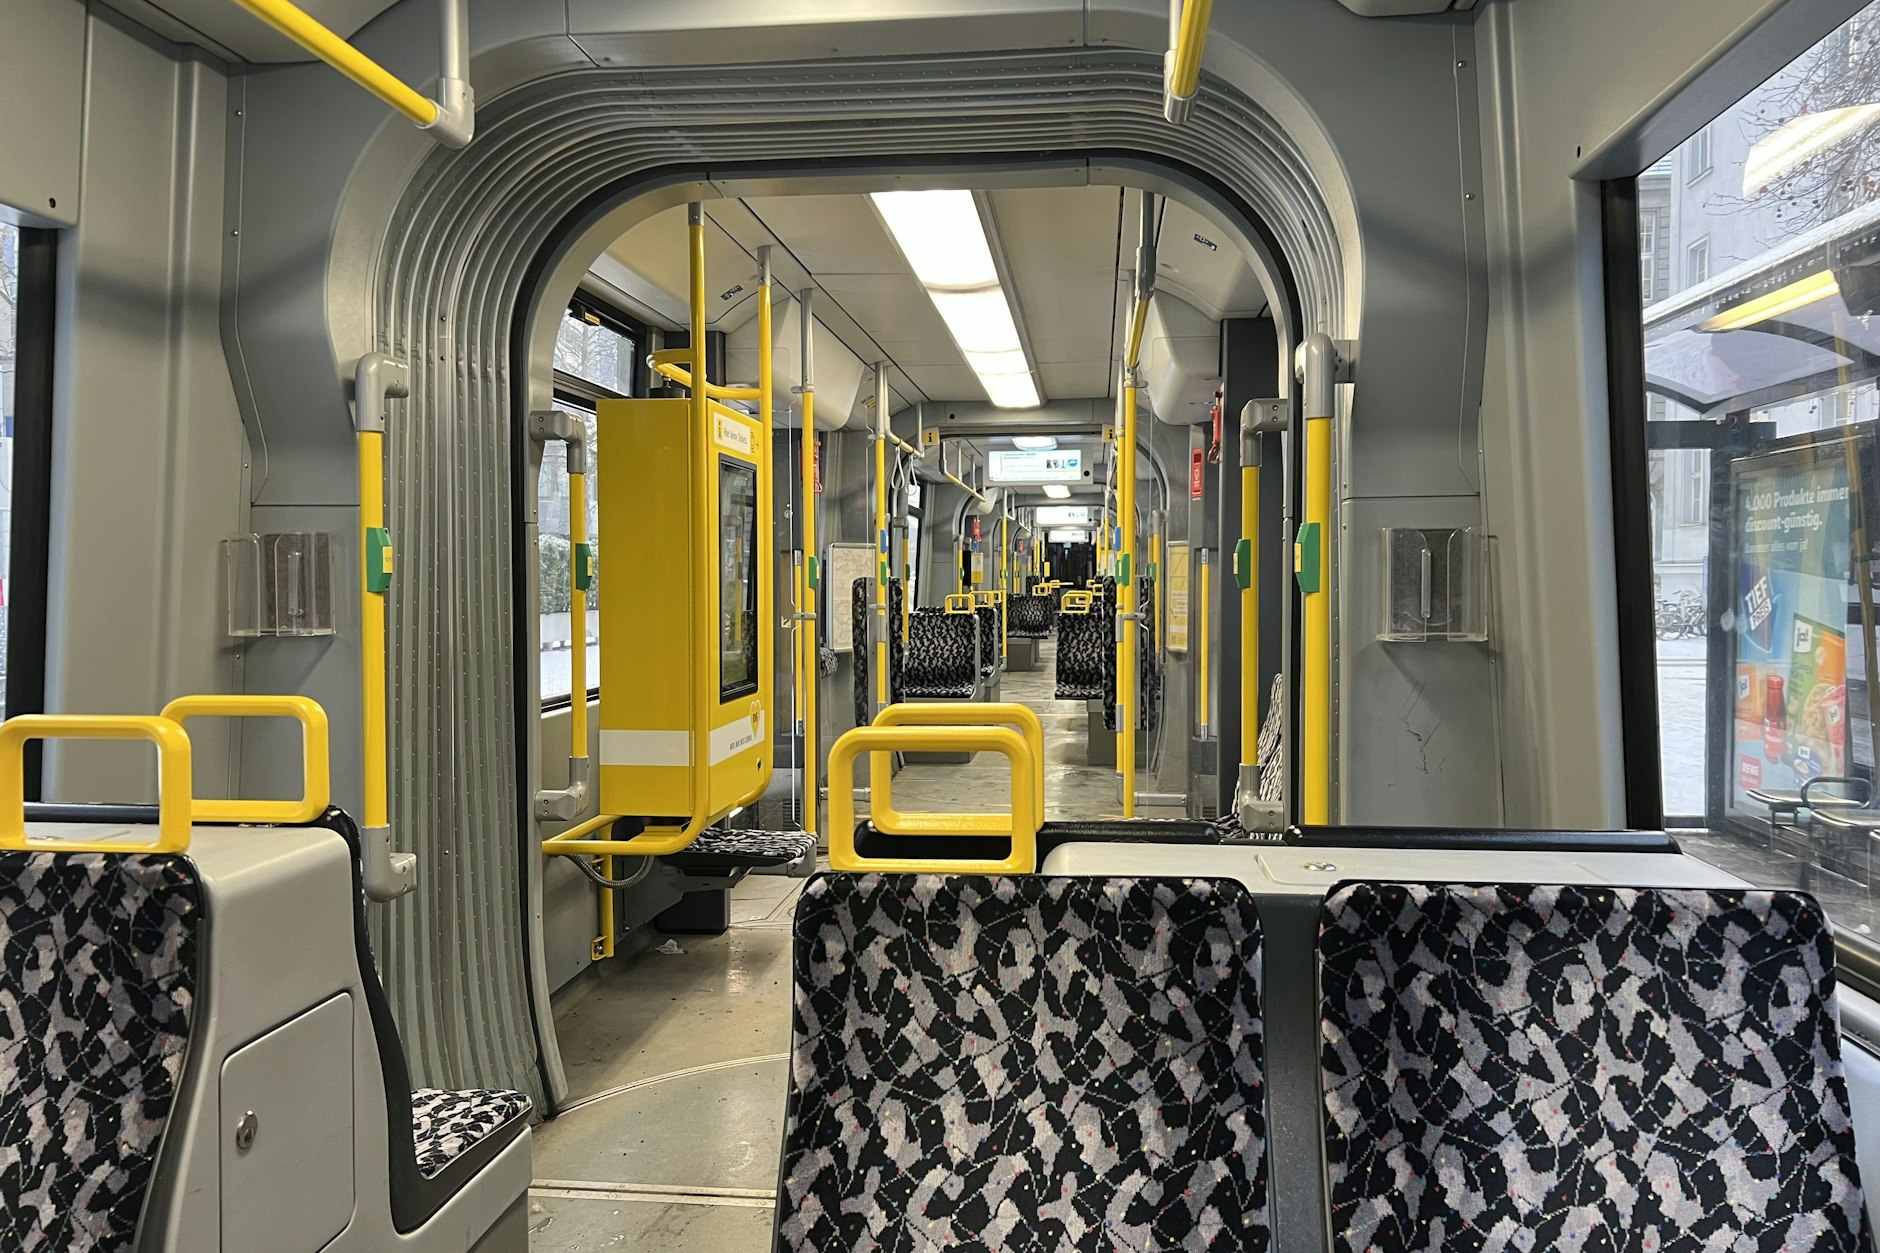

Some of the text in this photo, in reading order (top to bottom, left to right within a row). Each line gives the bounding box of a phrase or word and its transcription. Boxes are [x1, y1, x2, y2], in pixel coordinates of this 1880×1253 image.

[1745, 485, 1849, 511] 4.000 Produkte immer
[1745, 509, 1823, 534] discount-günstig.
[1744, 575, 1768, 614] TIEF
